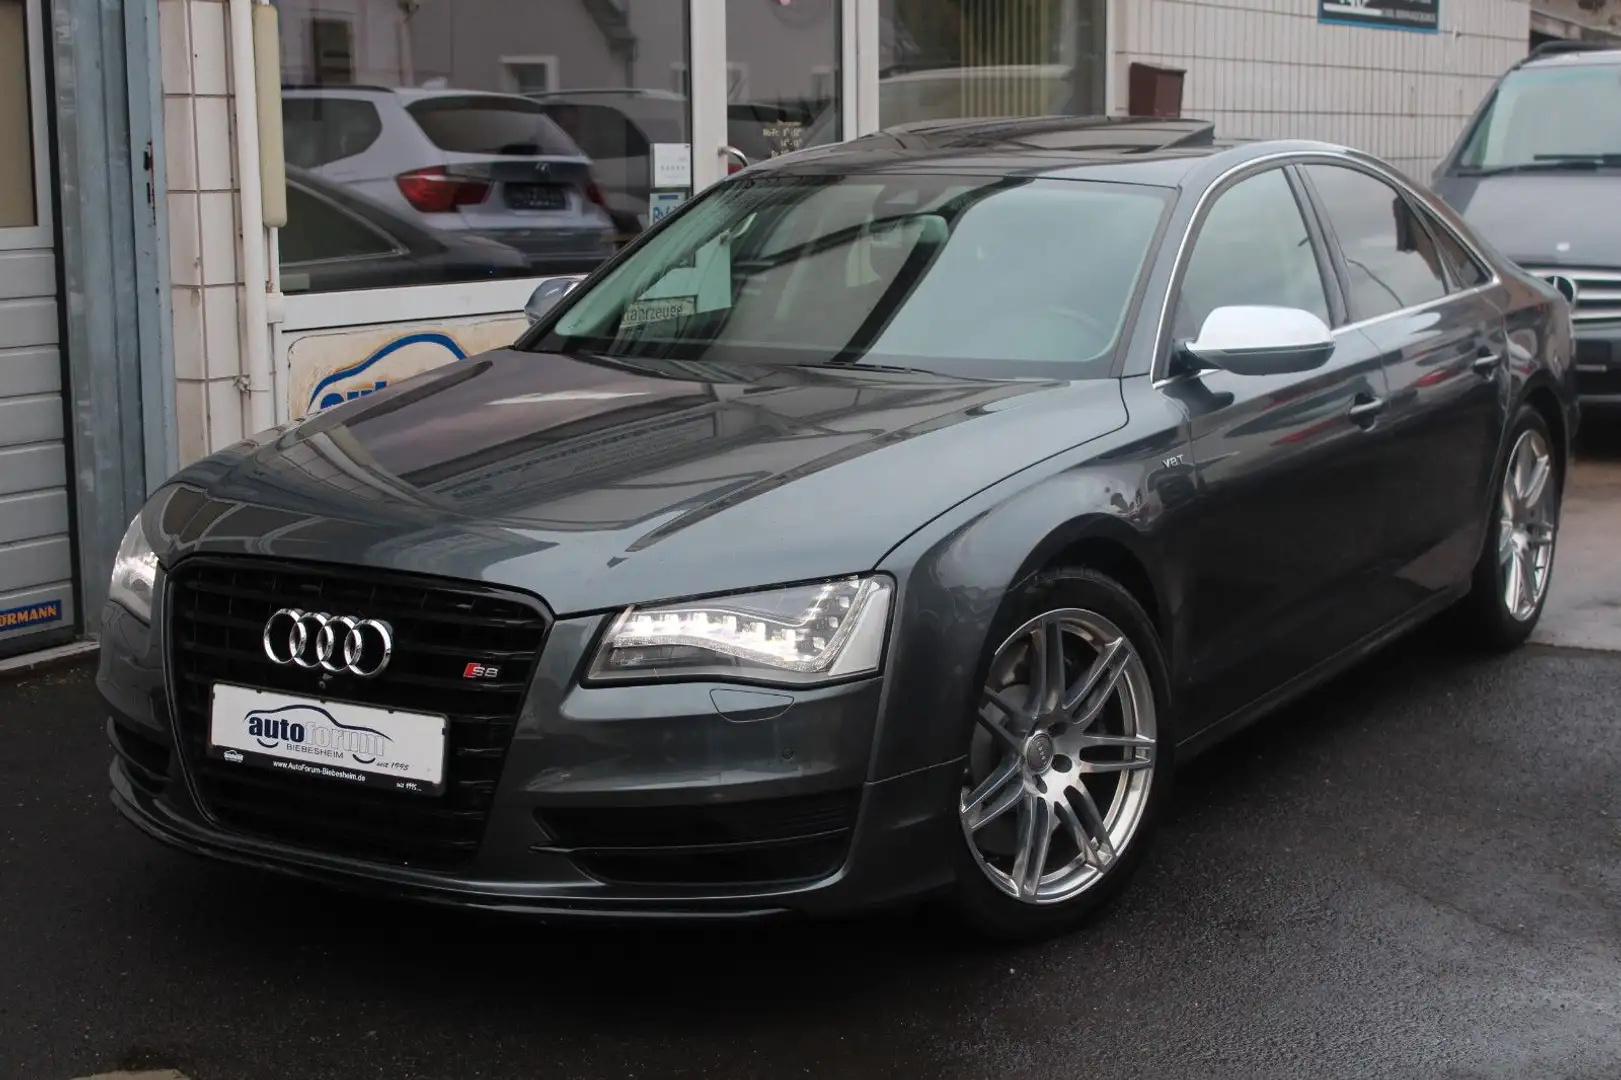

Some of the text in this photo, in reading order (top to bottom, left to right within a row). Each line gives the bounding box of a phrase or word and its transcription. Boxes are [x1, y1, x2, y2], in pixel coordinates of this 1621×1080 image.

[1162, 454, 1184, 469] V8T
[472, 666, 499, 678] S8
[286, 743, 345, 759] BIEBESHEIM
[390, 761, 410, 772] 1995
